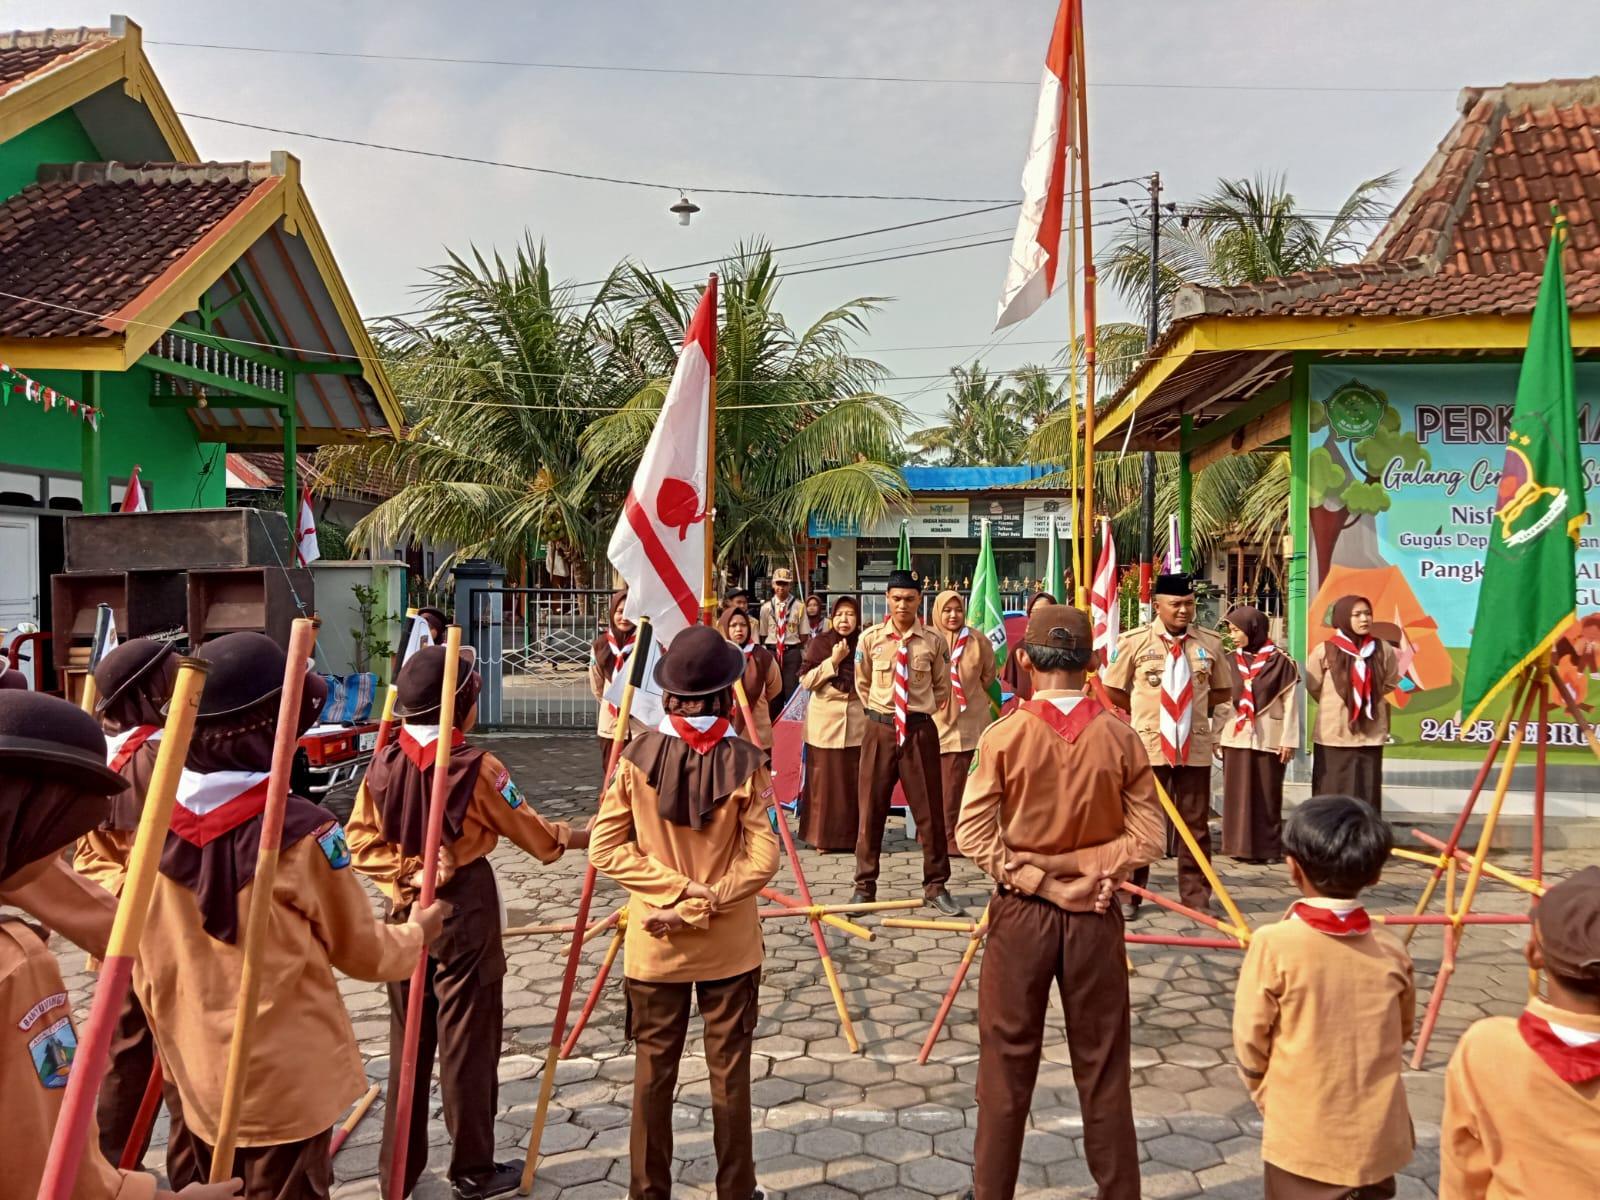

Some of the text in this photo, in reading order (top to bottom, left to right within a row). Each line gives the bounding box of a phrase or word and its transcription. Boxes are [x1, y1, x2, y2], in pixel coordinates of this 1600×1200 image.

[1415, 404, 1515, 444] PERK
[1384, 456, 1465, 496] Galang
[1451, 506, 1495, 525] Nisf
[1400, 532, 1452, 550] Gugus
[1457, 532, 1488, 550] Dep
[1421, 560, 1484, 583] Pangk
